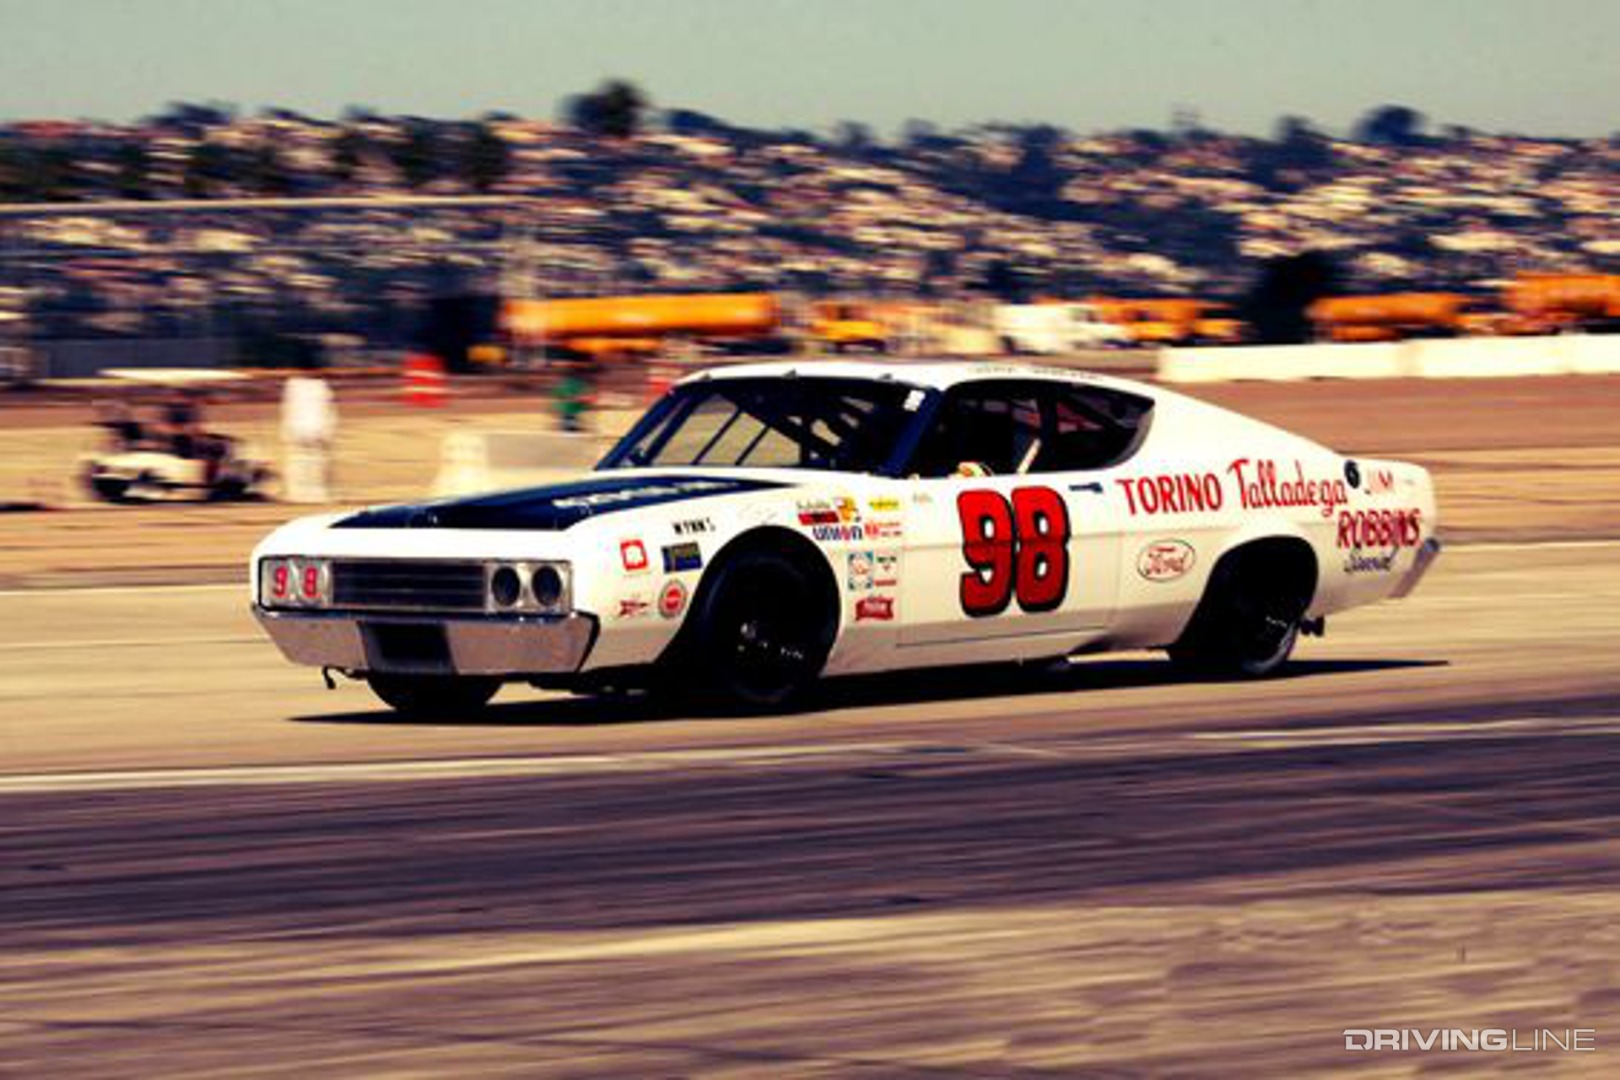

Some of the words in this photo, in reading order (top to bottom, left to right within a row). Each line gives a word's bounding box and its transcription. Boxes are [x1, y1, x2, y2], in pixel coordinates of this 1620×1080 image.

[1115, 471, 1222, 516] TORINO
[1227, 457, 1348, 518] Talladega
[957, 486, 1072, 618] 98
[1336, 507, 1421, 549] ROBBINS
